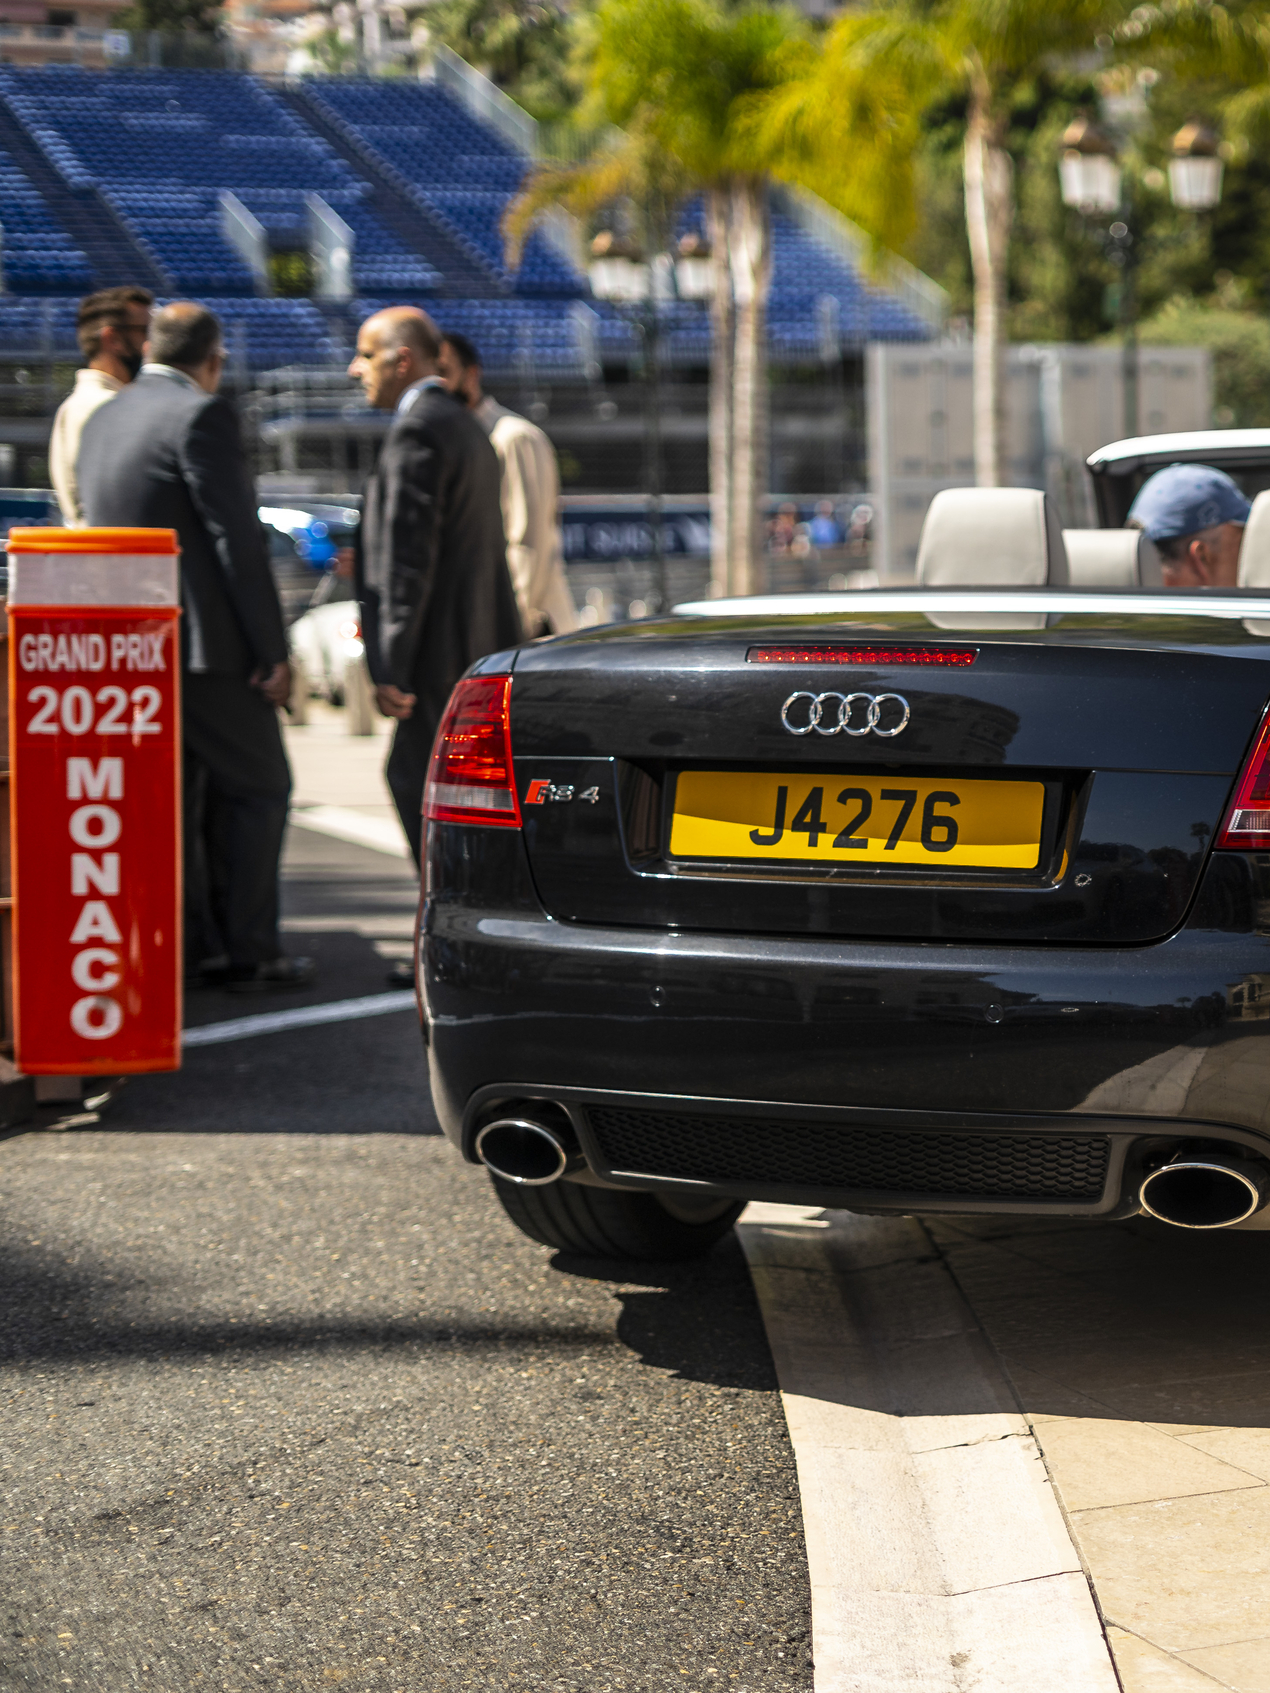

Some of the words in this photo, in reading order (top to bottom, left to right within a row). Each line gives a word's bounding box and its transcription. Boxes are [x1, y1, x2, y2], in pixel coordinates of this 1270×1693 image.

[20, 634, 105, 672] GRAND
[111, 634, 166, 671] PRIX
[27, 686, 162, 734] 2022
[749, 785, 961, 853] J4276
[67, 756, 123, 1039] MONACO
